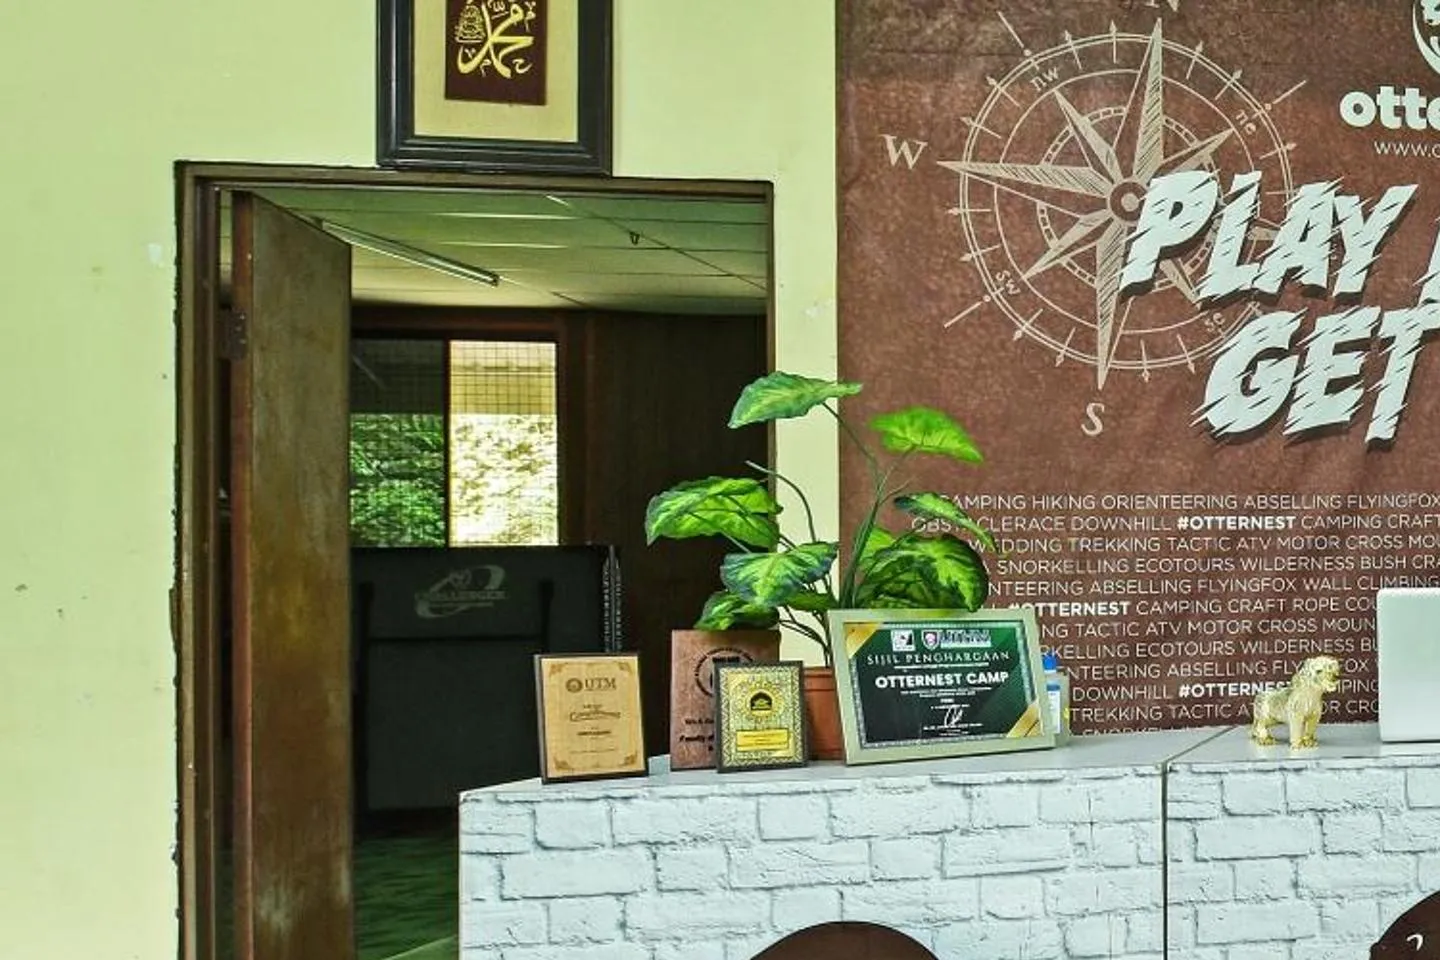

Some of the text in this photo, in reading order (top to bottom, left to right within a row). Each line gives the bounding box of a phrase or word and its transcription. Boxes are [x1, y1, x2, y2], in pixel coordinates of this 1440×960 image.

[881, 134, 928, 170] W
[1119, 170, 1418, 300] PLAY
[1080, 402, 1106, 436] S
[940, 495, 1026, 510] AMPING
[1032, 495, 1095, 510] HIKING
[1101, 495, 1237, 509] ORIENTEERING
[1243, 494, 1341, 509] ABSELLING
[1071, 516, 1170, 531] DOWNHILL
[1177, 515, 1295, 530] #OTTERNEST
[1301, 514, 1381, 529] CAMPING
[968, 538, 1062, 552] WDDING
[1068, 537, 1160, 552] TREKKING
[1166, 536, 1230, 551] TACTIC
[1236, 536, 1271, 550] ATV
[1277, 535, 1341, 550] MOTOR
[1345, 534, 1402, 549] CROSS
[996, 558, 1129, 574] SNORKELLING
[1135, 556, 1235, 572] ECOTOURS
[1239, 554, 1354, 570] WILDERNESS
[1360, 554, 1406, 569] BUSH
[1089, 578, 1191, 594] ABSELLING
[1197, 577, 1296, 592] FLYINGFOX
[1302, 576, 1351, 591] WALL
[1135, 599, 1221, 615] CAMPING
[1227, 599, 1285, 614] CRAFT
[1292, 598, 1339, 613] ROPE
[1074, 621, 1139, 637] TACTIC
[1145, 620, 1182, 635] ATV
[1186, 619, 1252, 634] MOTOR
[1258, 618, 1317, 633] CROSS
[1135, 641, 1235, 657] ECOTOURS
[1239, 639, 1354, 655] WILDERNESS
[906, 651, 1010, 664] PENGHARGAAN
[1167, 660, 1268, 677] ABSELLING
[585, 677, 616, 690] UTM
[875, 671, 1009, 689] OTTERNEST CAMP
[1072, 683, 1170, 700] DOWNHILL
[1070, 705, 1162, 721] TREKKING
[1169, 703, 1232, 719] TACTIC
